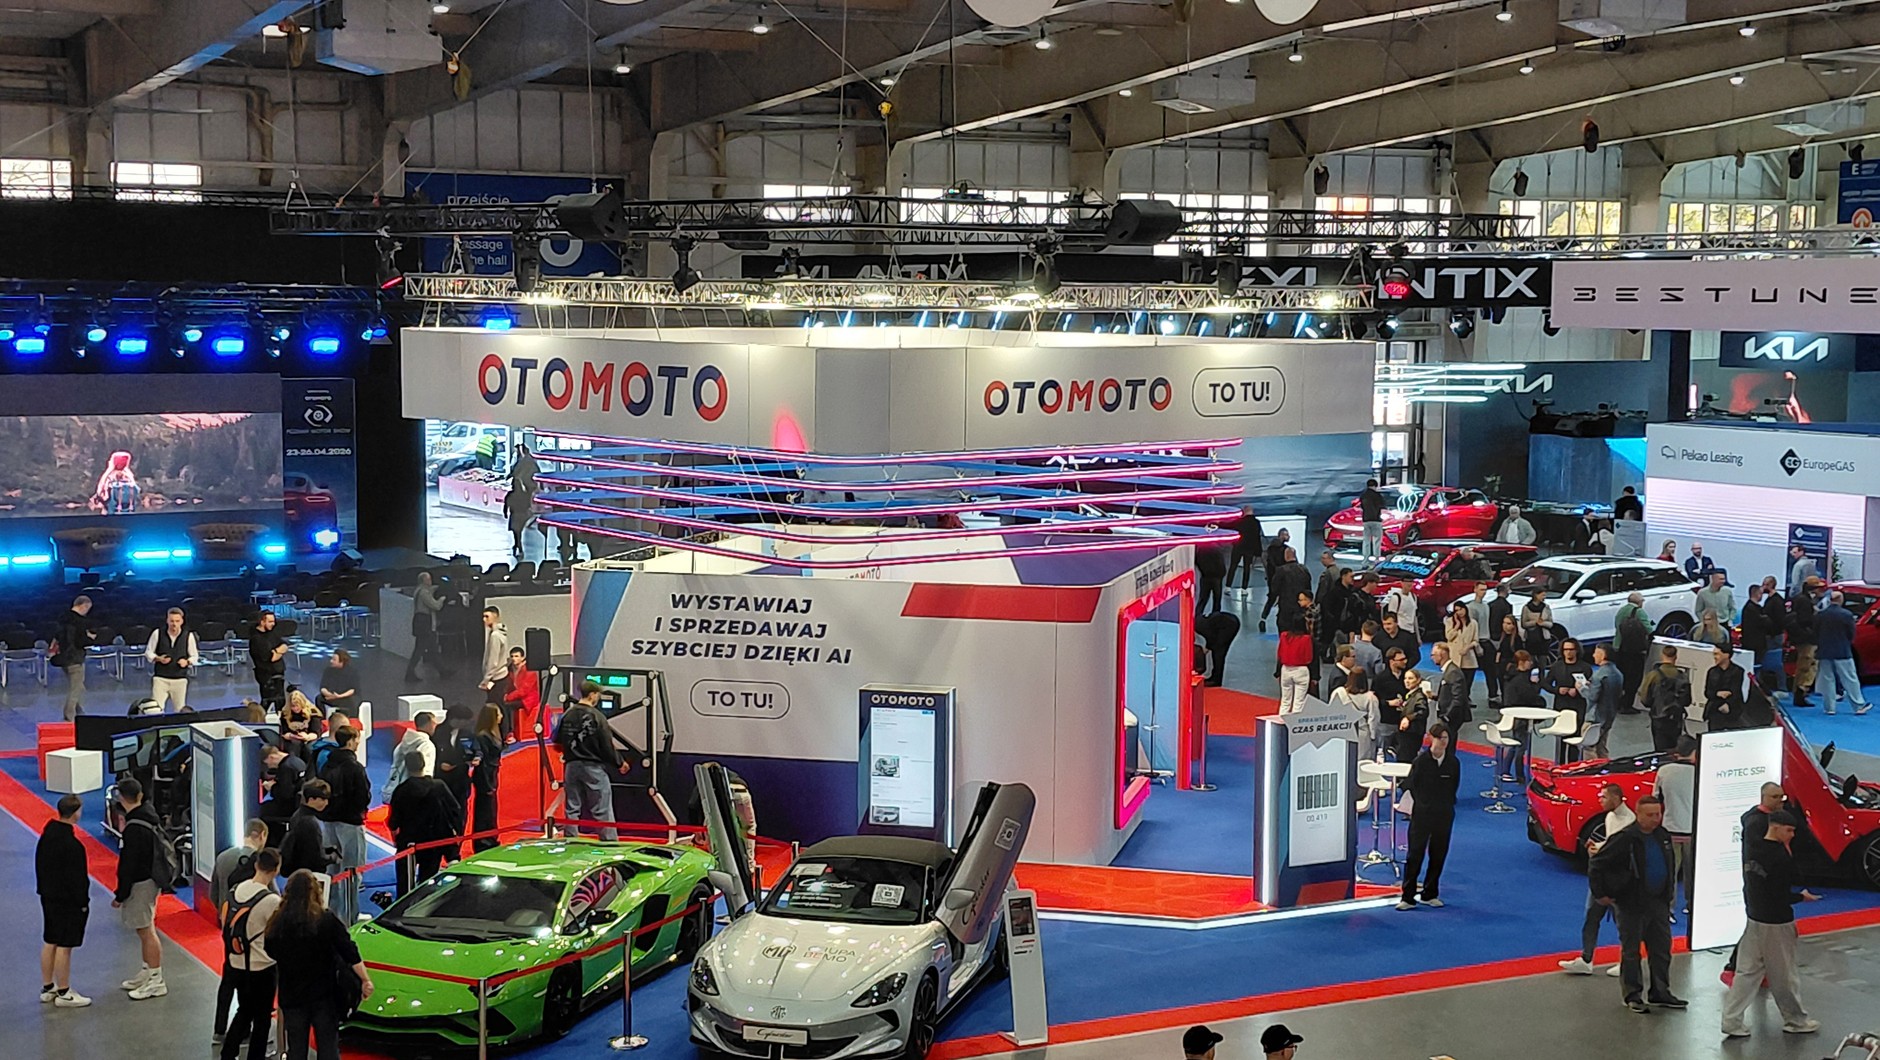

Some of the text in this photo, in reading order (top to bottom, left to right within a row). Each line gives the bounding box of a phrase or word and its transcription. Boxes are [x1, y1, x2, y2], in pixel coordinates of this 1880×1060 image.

[1572, 287, 1879, 304] BESTUNE
[478, 353, 728, 421] OTOMOTO
[983, 376, 1172, 416] OTOMOTO
[1209, 381, 1270, 403] TO TU!
[286, 448, 352, 456] 23-26.04.2026
[1681, 449, 1743, 467] Pekao Leasing
[1803, 459, 1855, 472] EuropeGAS
[671, 593, 812, 614] WYSTAWIAJ
[655, 617, 827, 639] I SPRZEDAWAJ
[631, 639, 851, 666] SZYBCIEJ DZIĘKI AI
[707, 690, 773, 709] TO TU!
[871, 694, 935, 707] OTOMOTO
[1292, 722, 1352, 734] CZAS REAKCJI
[1716, 767, 1748, 778] HYPTEC
